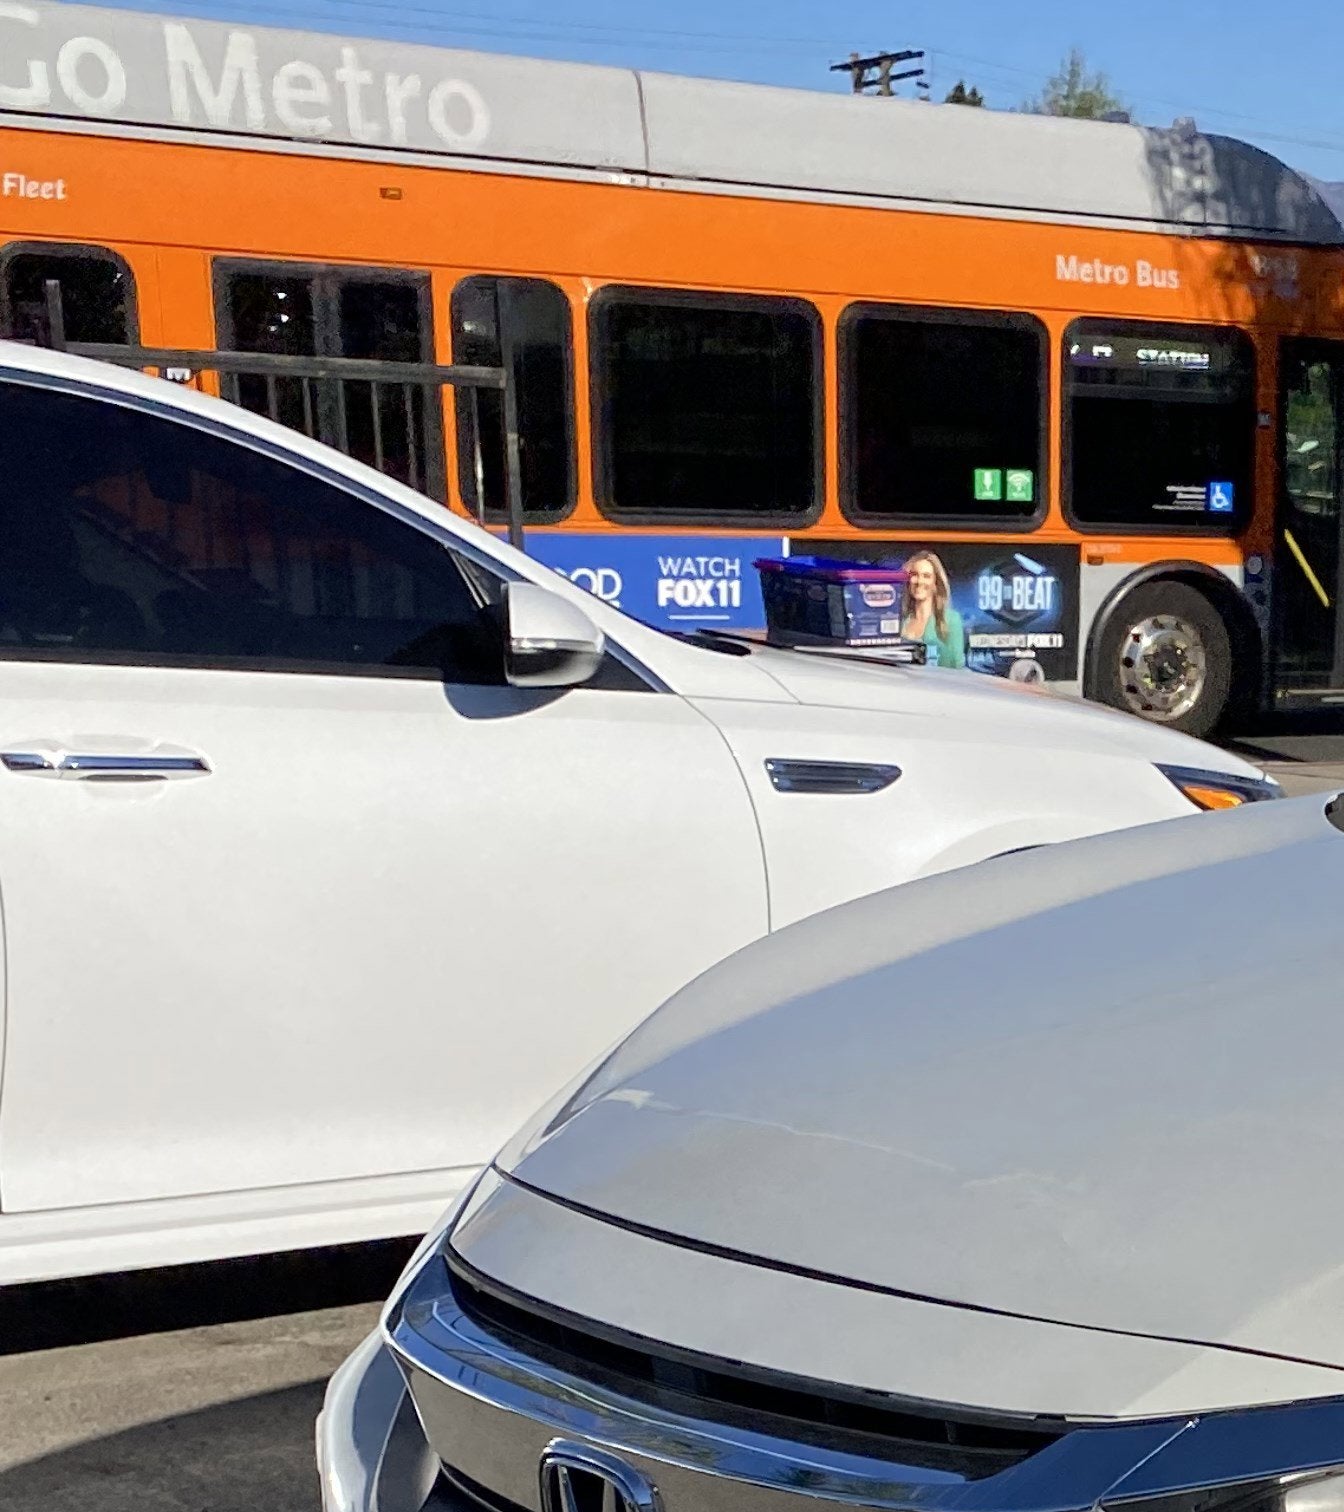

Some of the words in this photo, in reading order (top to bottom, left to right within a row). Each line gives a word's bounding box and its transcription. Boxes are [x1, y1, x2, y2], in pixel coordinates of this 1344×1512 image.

[0, 2, 126, 115] Go
[163, 22, 491, 151] Metro
[1, 173, 66, 201] Fleet
[1055, 254, 1130, 286] Metro
[1136, 259, 1180, 290] Bus
[657, 556, 742, 577] WATCH
[977, 575, 1003, 611] 99
[1012, 576, 1055, 610] BEAT
